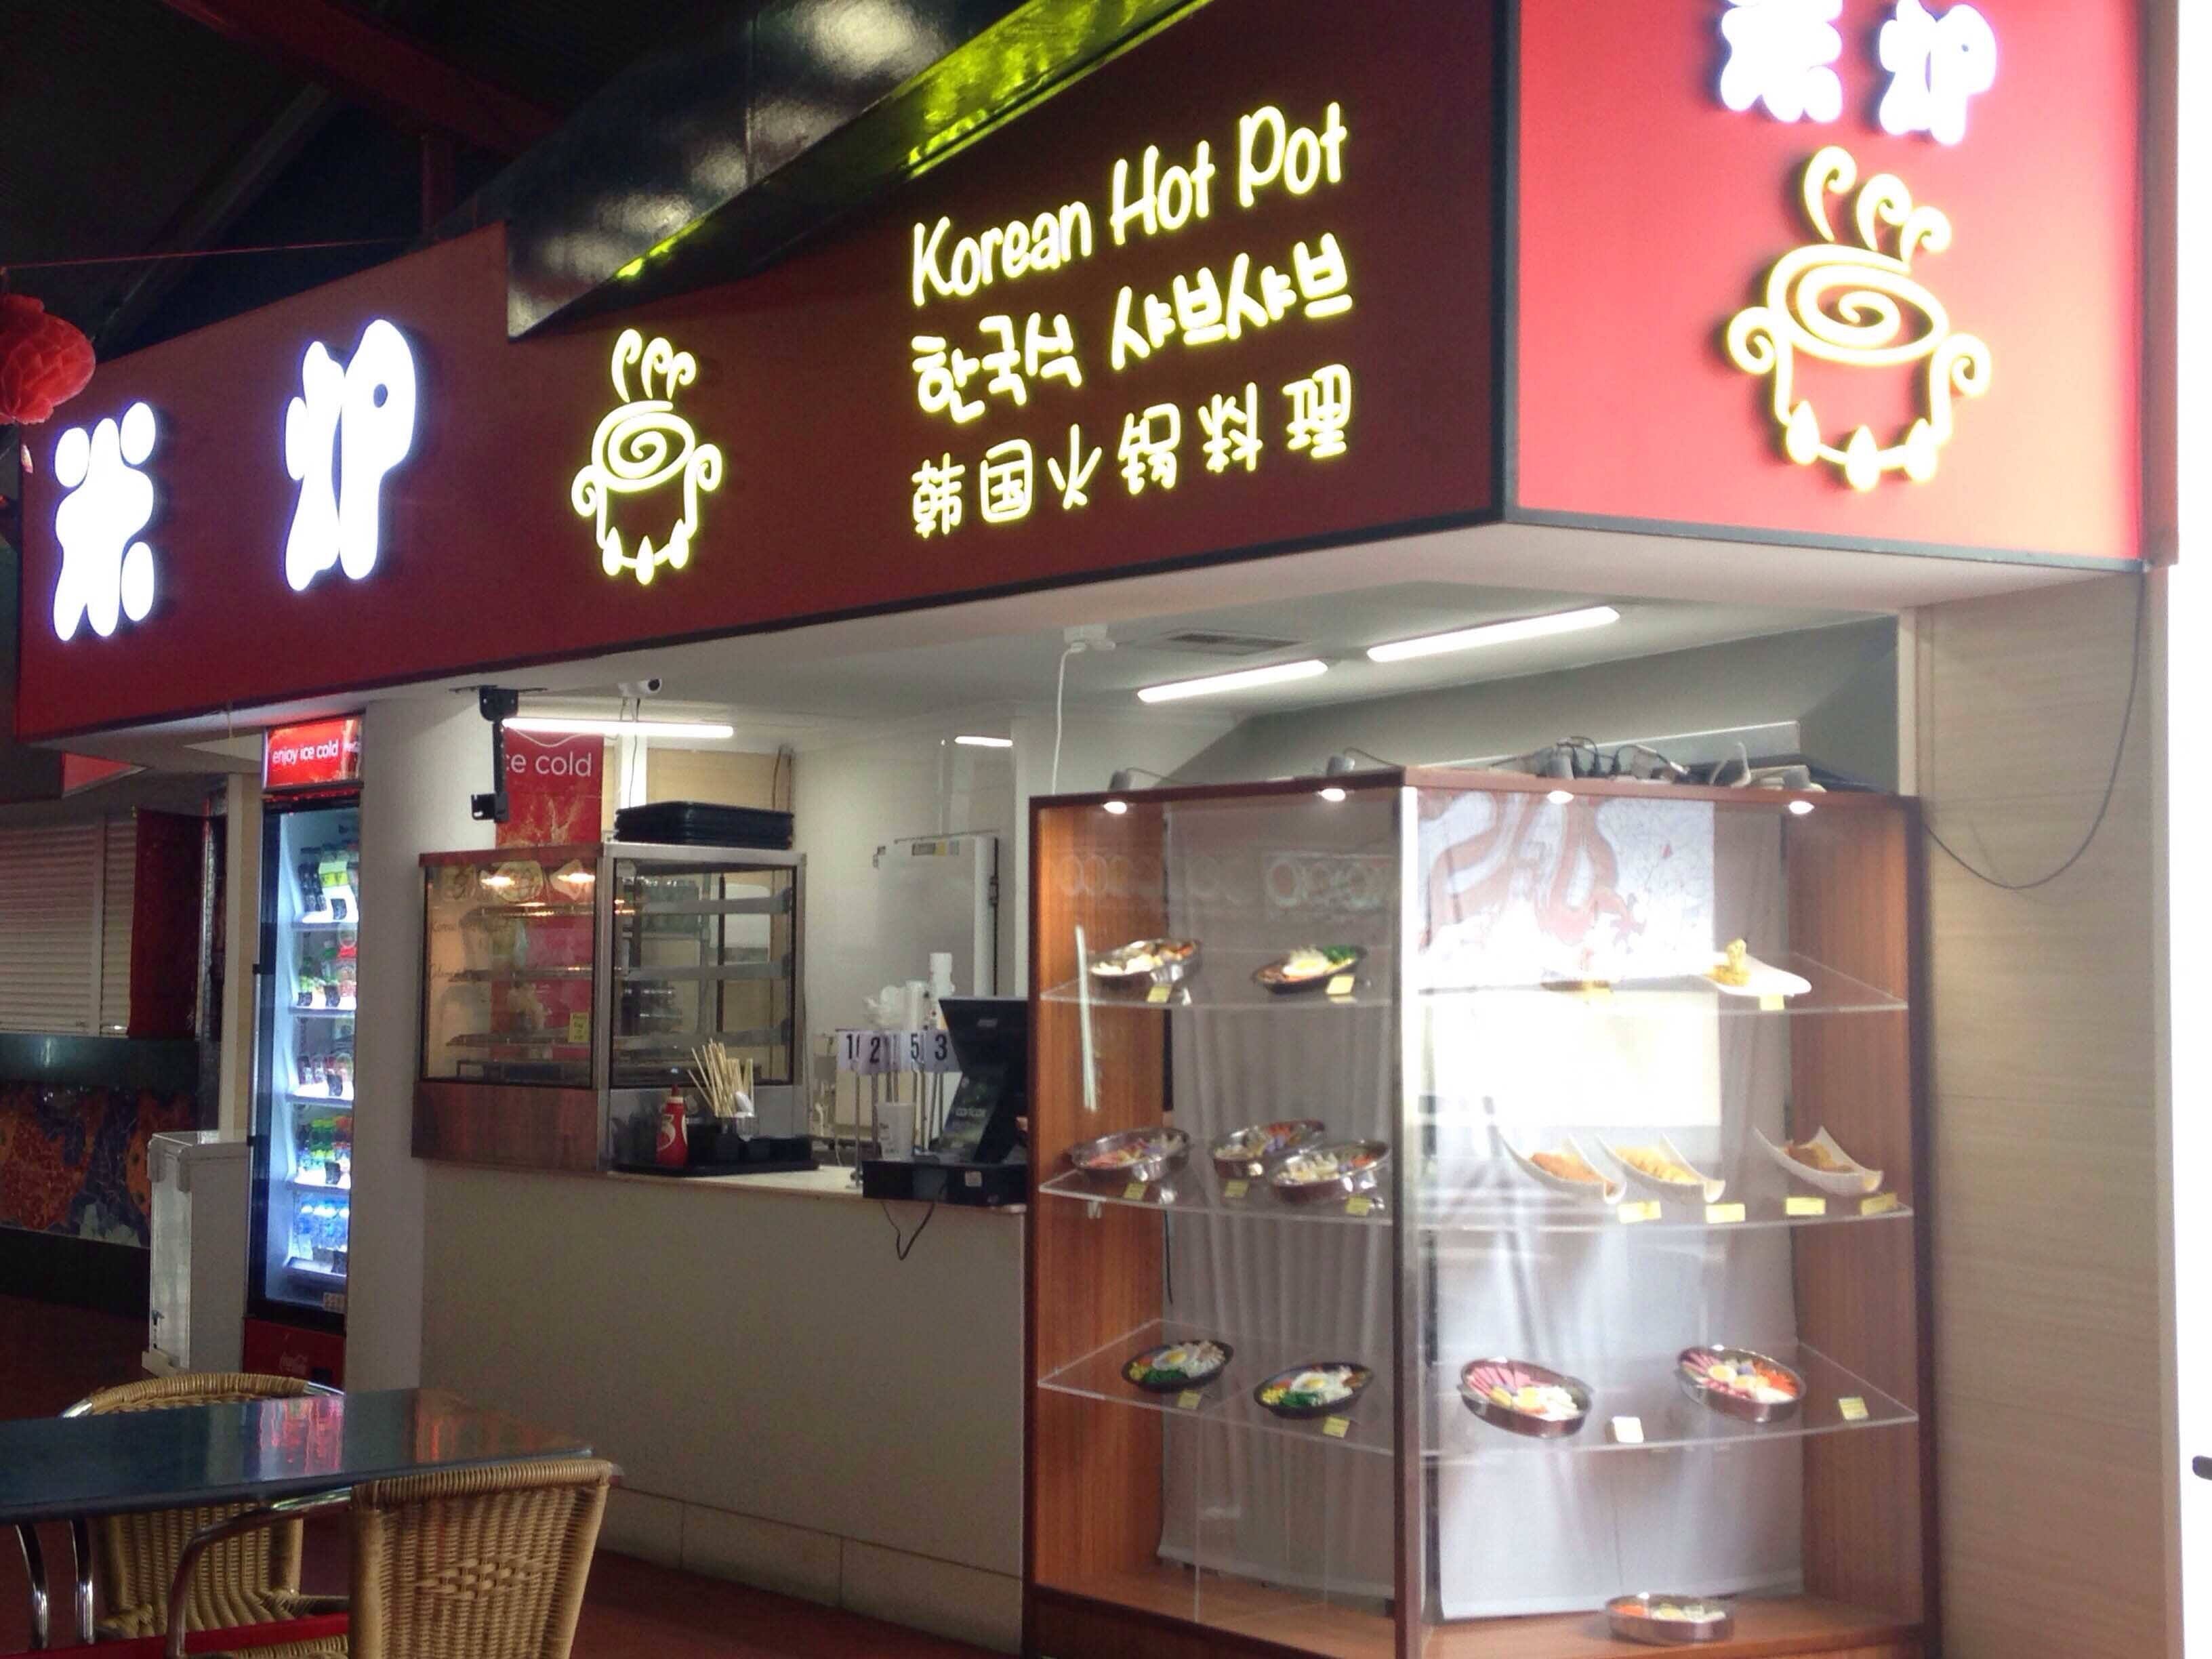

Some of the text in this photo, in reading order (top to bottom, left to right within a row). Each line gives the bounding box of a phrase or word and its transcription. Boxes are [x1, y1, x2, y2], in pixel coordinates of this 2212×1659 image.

[912, 101, 1348, 307] Korean Hot Pot
[912, 232, 1353, 424] 한국식 샤브샤브
[912, 364, 1352, 539] 韩国火锅料理
[272, 746, 298, 766] enjoy
[300, 743, 314, 761] ice
[316, 739, 340, 760] cold
[535, 752, 592, 777] cold
[869, 1037, 881, 1063] 2
[935, 1033, 948, 1061] 3
